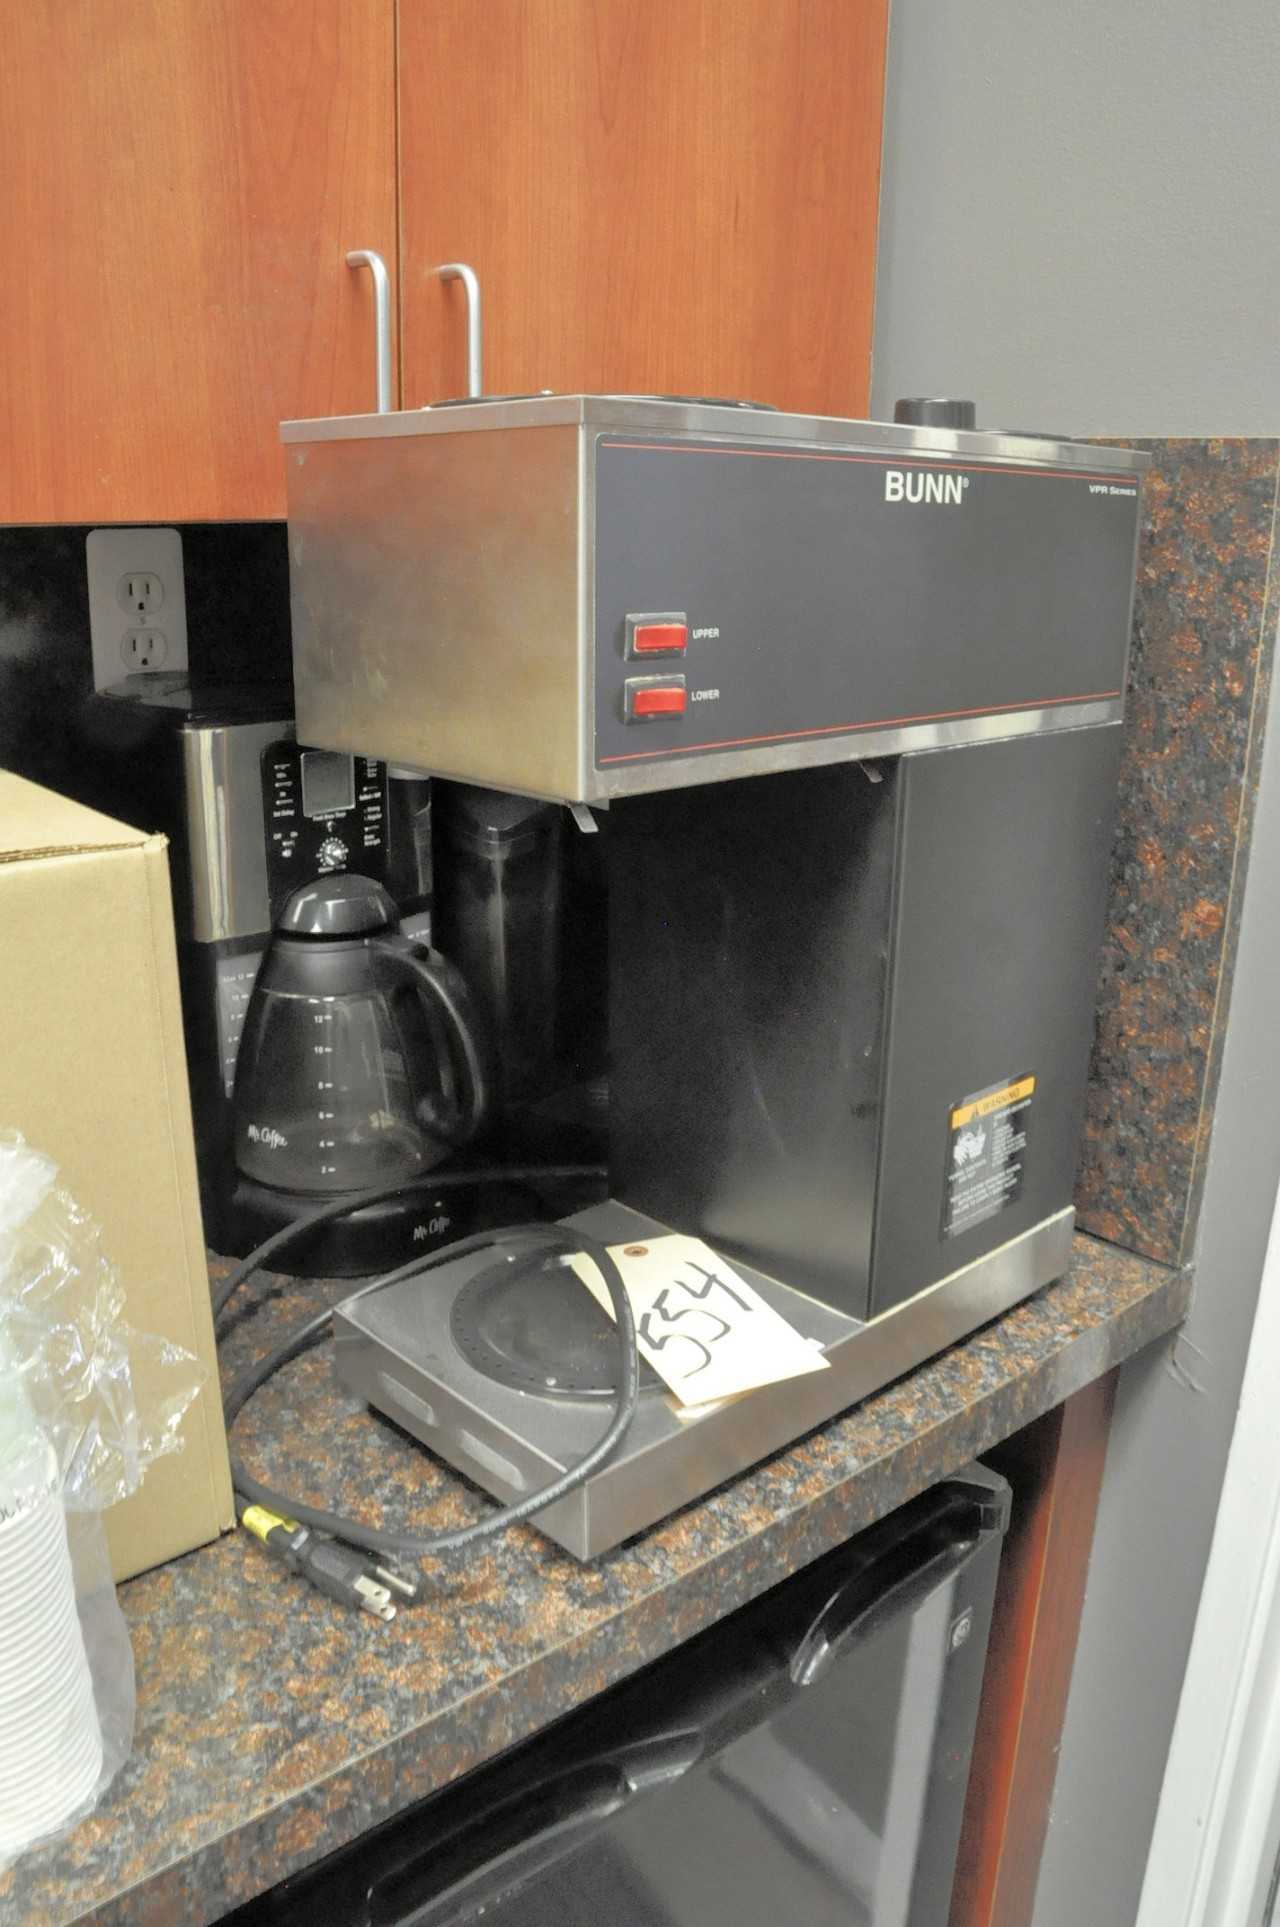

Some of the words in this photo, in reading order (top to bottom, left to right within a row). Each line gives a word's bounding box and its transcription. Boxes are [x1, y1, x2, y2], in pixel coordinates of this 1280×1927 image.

[1089, 485, 1108, 495] VPR
[692, 627, 720, 639] UPPER
[691, 690, 720, 702] LOWER
[314, 1015, 323, 1024] 12
[638, 1260, 753, 1379] 554
